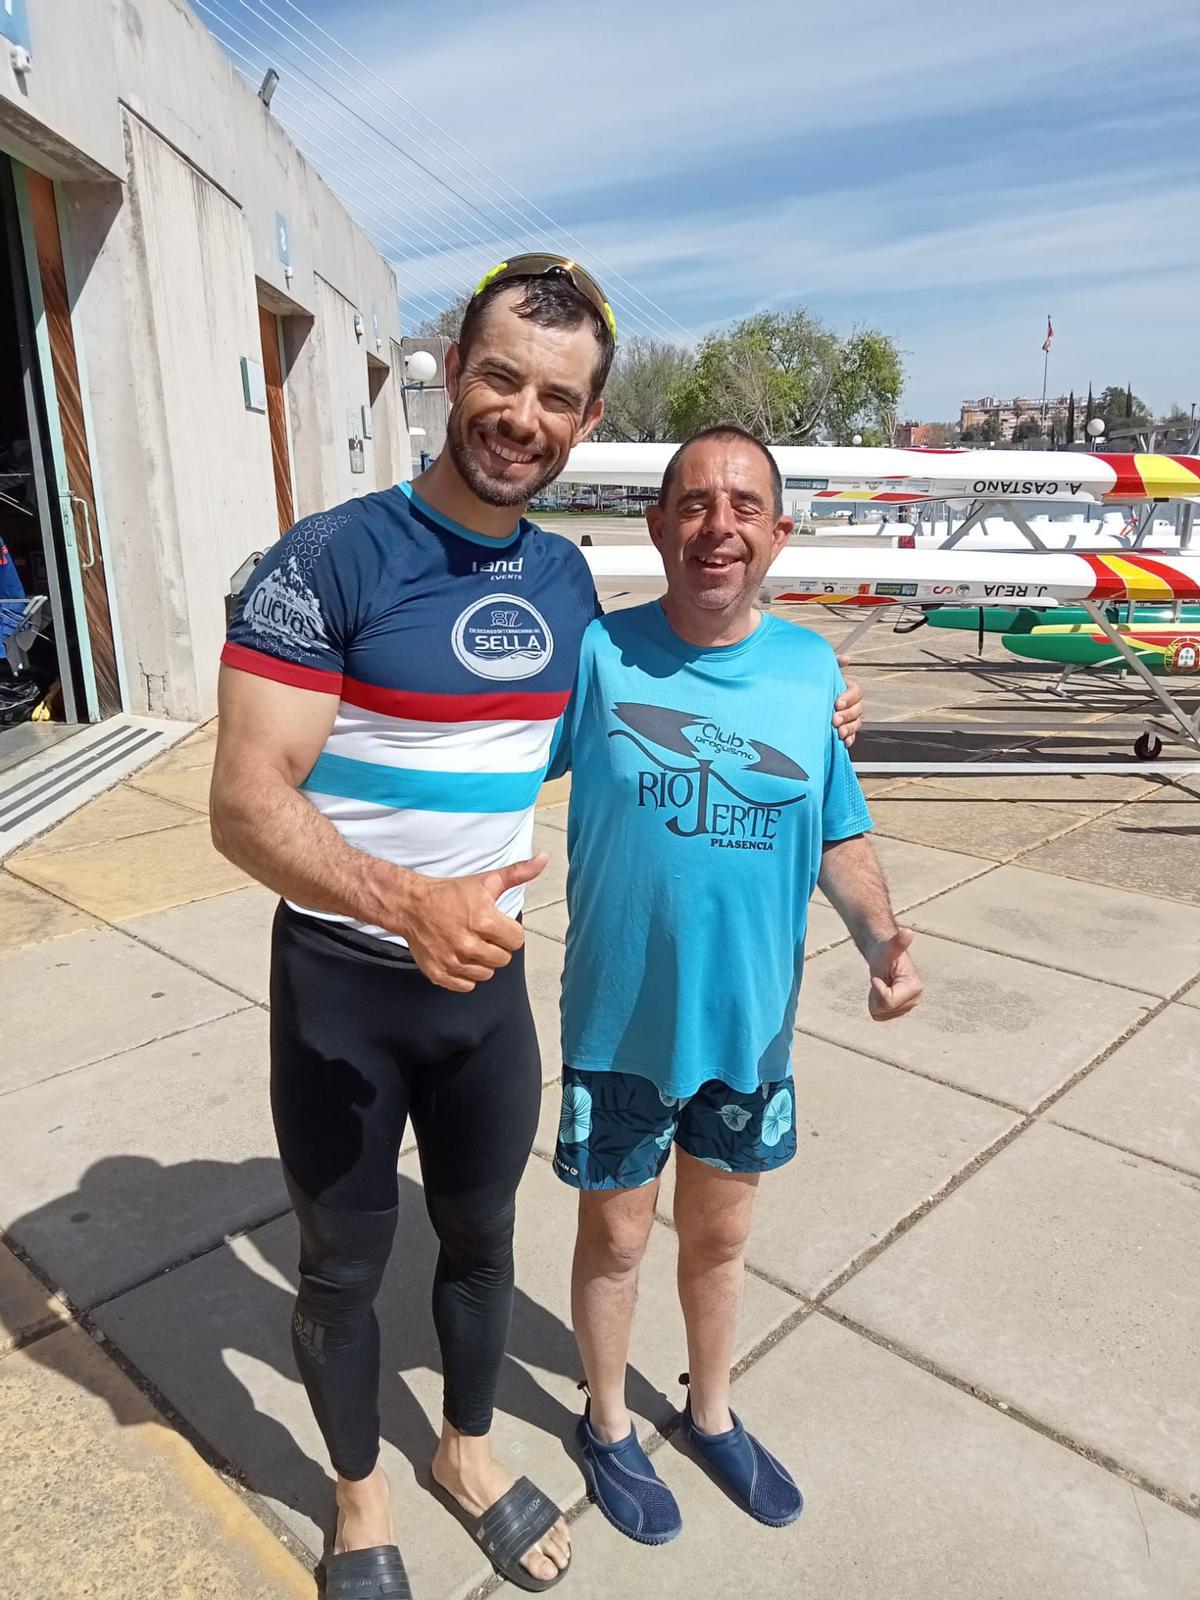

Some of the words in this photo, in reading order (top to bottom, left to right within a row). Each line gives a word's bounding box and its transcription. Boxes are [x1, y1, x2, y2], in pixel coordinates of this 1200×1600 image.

[1065, 482, 1082, 496] A.
[984, 584, 1029, 598] REJA
[1034, 585, 1048, 598] J.
[252, 587, 317, 640] Cuevas
[490, 610, 520, 627] 87
[474, 635, 541, 650] SELLA
[702, 723, 745, 749] Club
[694, 735, 755, 761] piraguismo
[665, 759, 782, 840] JERTE
[710, 838, 774, 851] PLASENCIA
